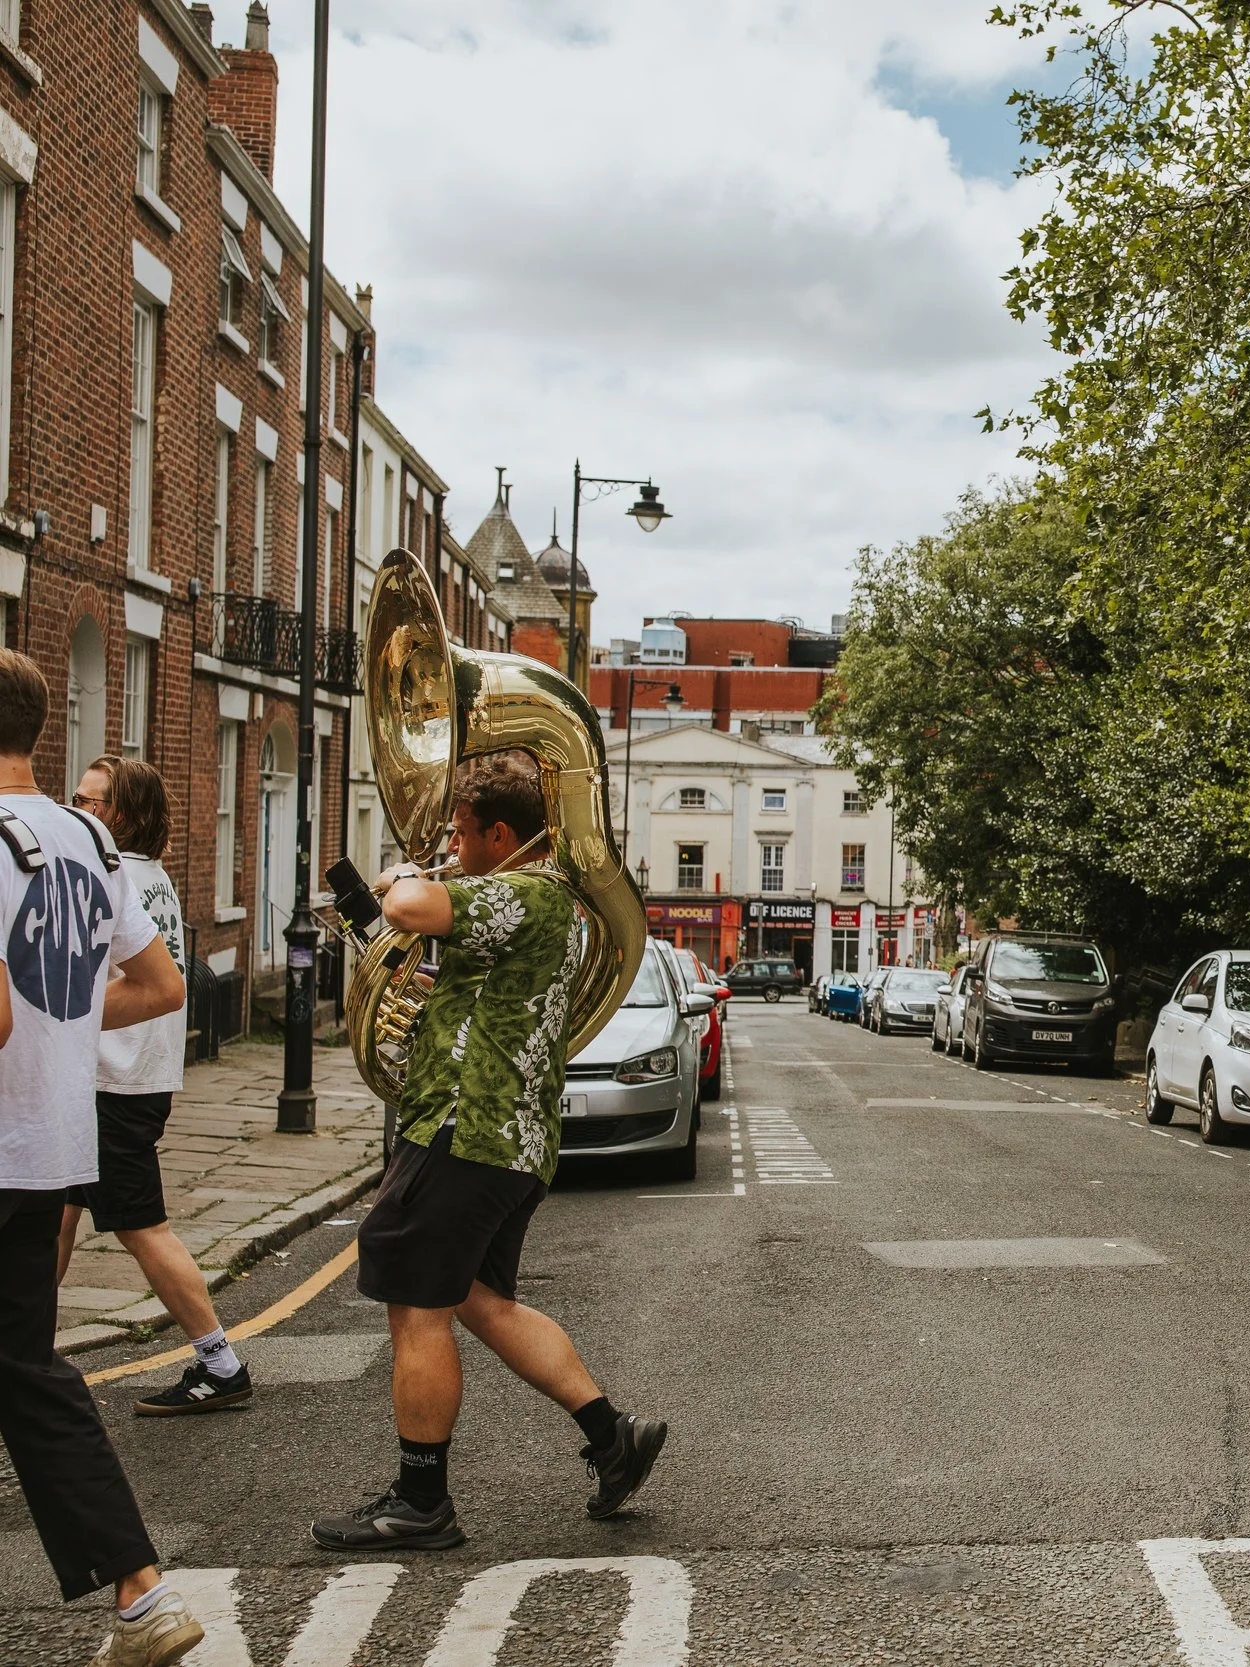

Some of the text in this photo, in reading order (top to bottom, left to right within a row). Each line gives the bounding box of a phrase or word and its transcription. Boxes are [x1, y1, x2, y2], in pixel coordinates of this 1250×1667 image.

[669, 908, 713, 918] NOODLE
[750, 905, 813, 918] OF LICENCE
